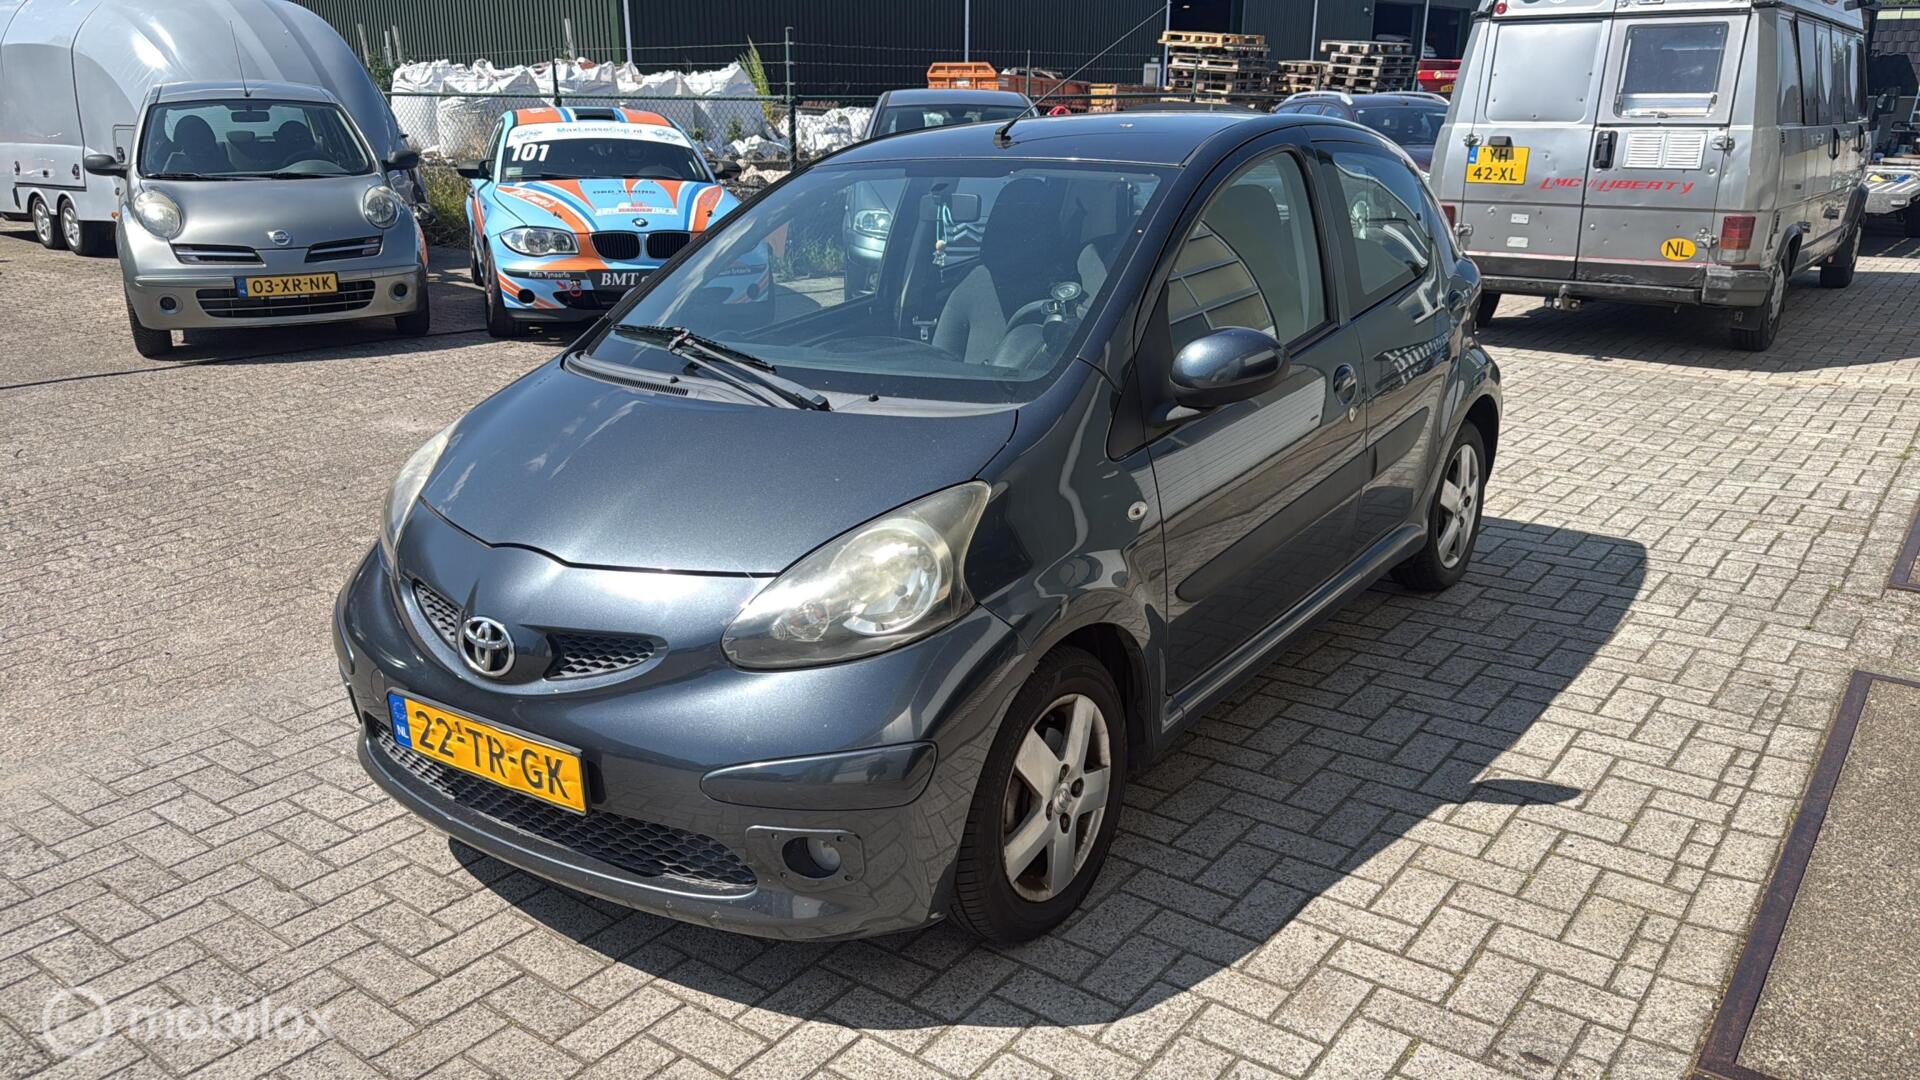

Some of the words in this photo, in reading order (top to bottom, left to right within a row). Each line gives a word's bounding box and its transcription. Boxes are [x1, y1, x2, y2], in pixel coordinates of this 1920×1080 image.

[511, 143, 550, 162] 101
[1489, 148, 1510, 163] YH
[1473, 166, 1518, 182] 42-XL
[1539, 177, 1584, 190] LMC
[1665, 241, 1690, 258] NL
[528, 271, 543, 279] Auto
[601, 272, 639, 286] BMT
[252, 276, 333, 294] 03-XR-NK
[396, 724, 409, 739] NL
[415, 710, 570, 800] 22-TR-GK
